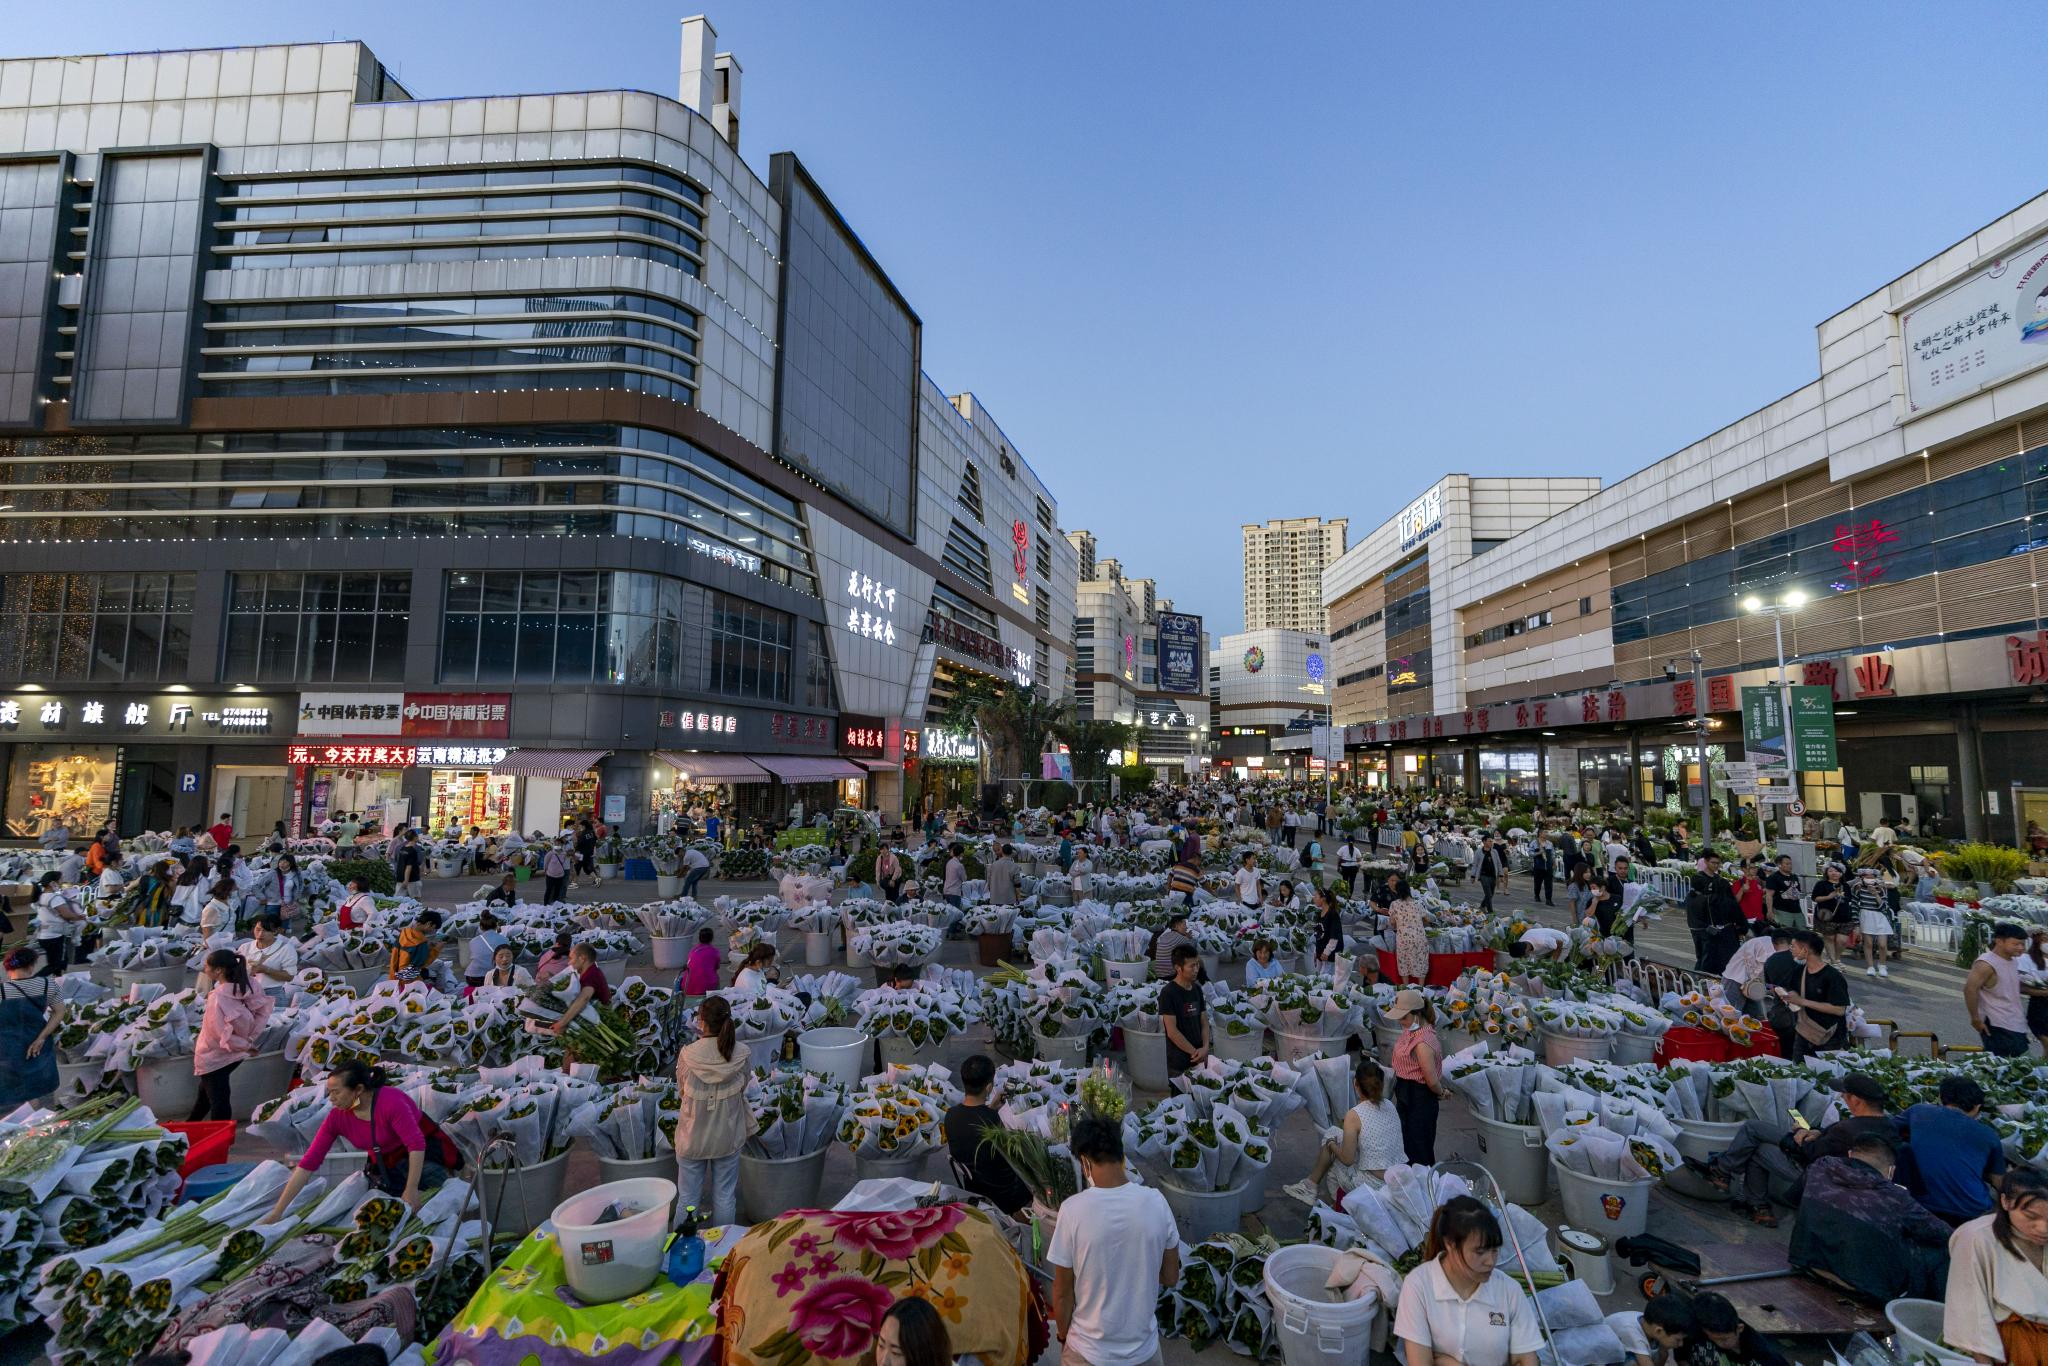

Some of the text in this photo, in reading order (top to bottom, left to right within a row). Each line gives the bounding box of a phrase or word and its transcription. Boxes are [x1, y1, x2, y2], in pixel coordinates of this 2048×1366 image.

[1913, 303, 2000, 352] 文明之花永远绽放
[1921, 312, 2012, 361] 礼仪之邦千古传承
[201, 712, 220, 721] TEL
[317, 703, 400, 720] 中国体育彩票
[420, 704, 506, 721] 中国福利彩票
[1516, 702, 1549, 728] 公正
[1582, 691, 1627, 722] 法治
[1793, 803, 1801, 812] 5
